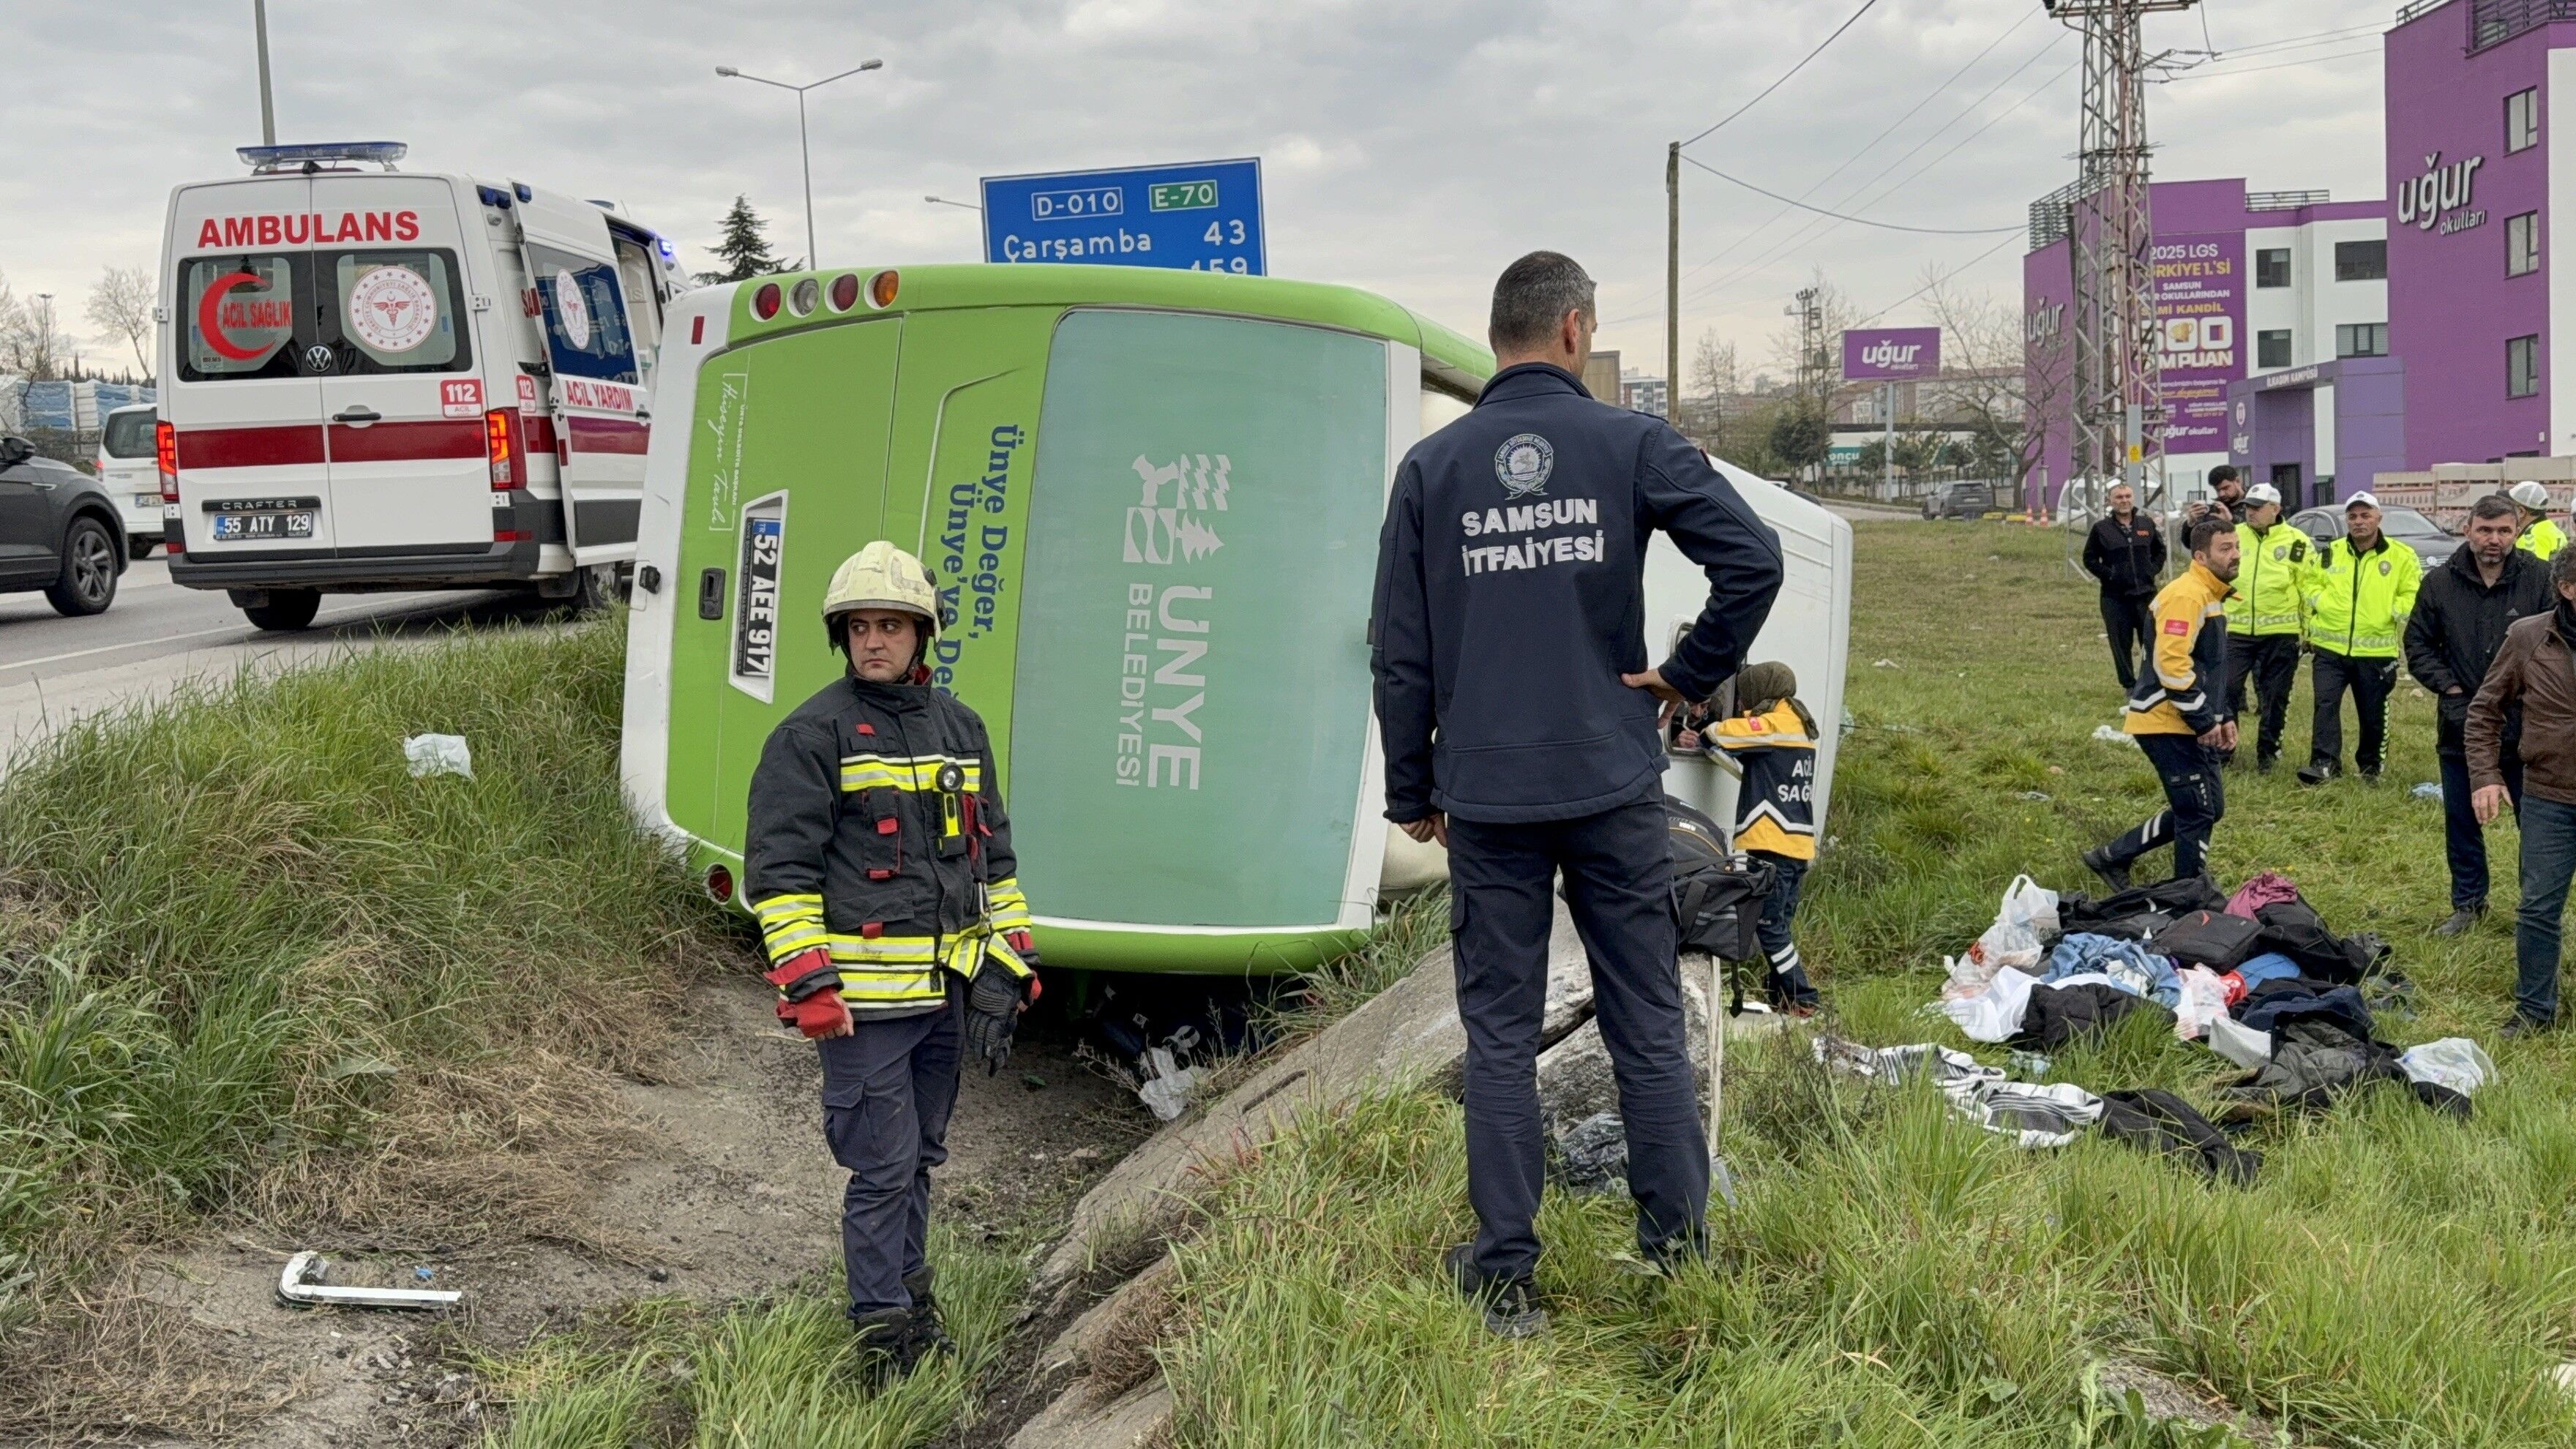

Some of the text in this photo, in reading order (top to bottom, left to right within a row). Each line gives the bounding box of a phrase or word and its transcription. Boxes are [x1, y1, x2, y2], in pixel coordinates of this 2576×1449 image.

[1037, 184, 1213, 217] D-010 E-70
[2398, 151, 2482, 231] uğur
[197, 211, 421, 248] AMBULANS
[2439, 209, 2487, 236] okulları
[1003, 219, 1246, 263] Çarşamba 43
[2150, 243, 2218, 260] 2025 LGS
[2161, 290, 2230, 301] OKULLARINDAN
[2163, 282, 2202, 291] SAMSUN
[222, 299, 292, 329] ACİL SAĞLIK
[2028, 296, 2064, 348] uğur
[2176, 301, 2225, 314] KANDİL
[1862, 340, 1922, 368] uğur
[2178, 351, 2233, 369] PUAN
[446, 383, 476, 402] 112
[518, 379, 533, 398] 112
[565, 380, 634, 411] ACİL YARDIM
[222, 500, 297, 510] CRAFTER
[1462, 498, 1598, 537] SAMSUN
[225, 514, 309, 533] 55 ATY 129
[968, 424, 1025, 640] Ünye Değer,
[1461, 529, 1604, 577] İTFAİYESİ
[746, 534, 778, 673] 52 AEE 917
[1116, 583, 1153, 787] BELEDİYESİ
